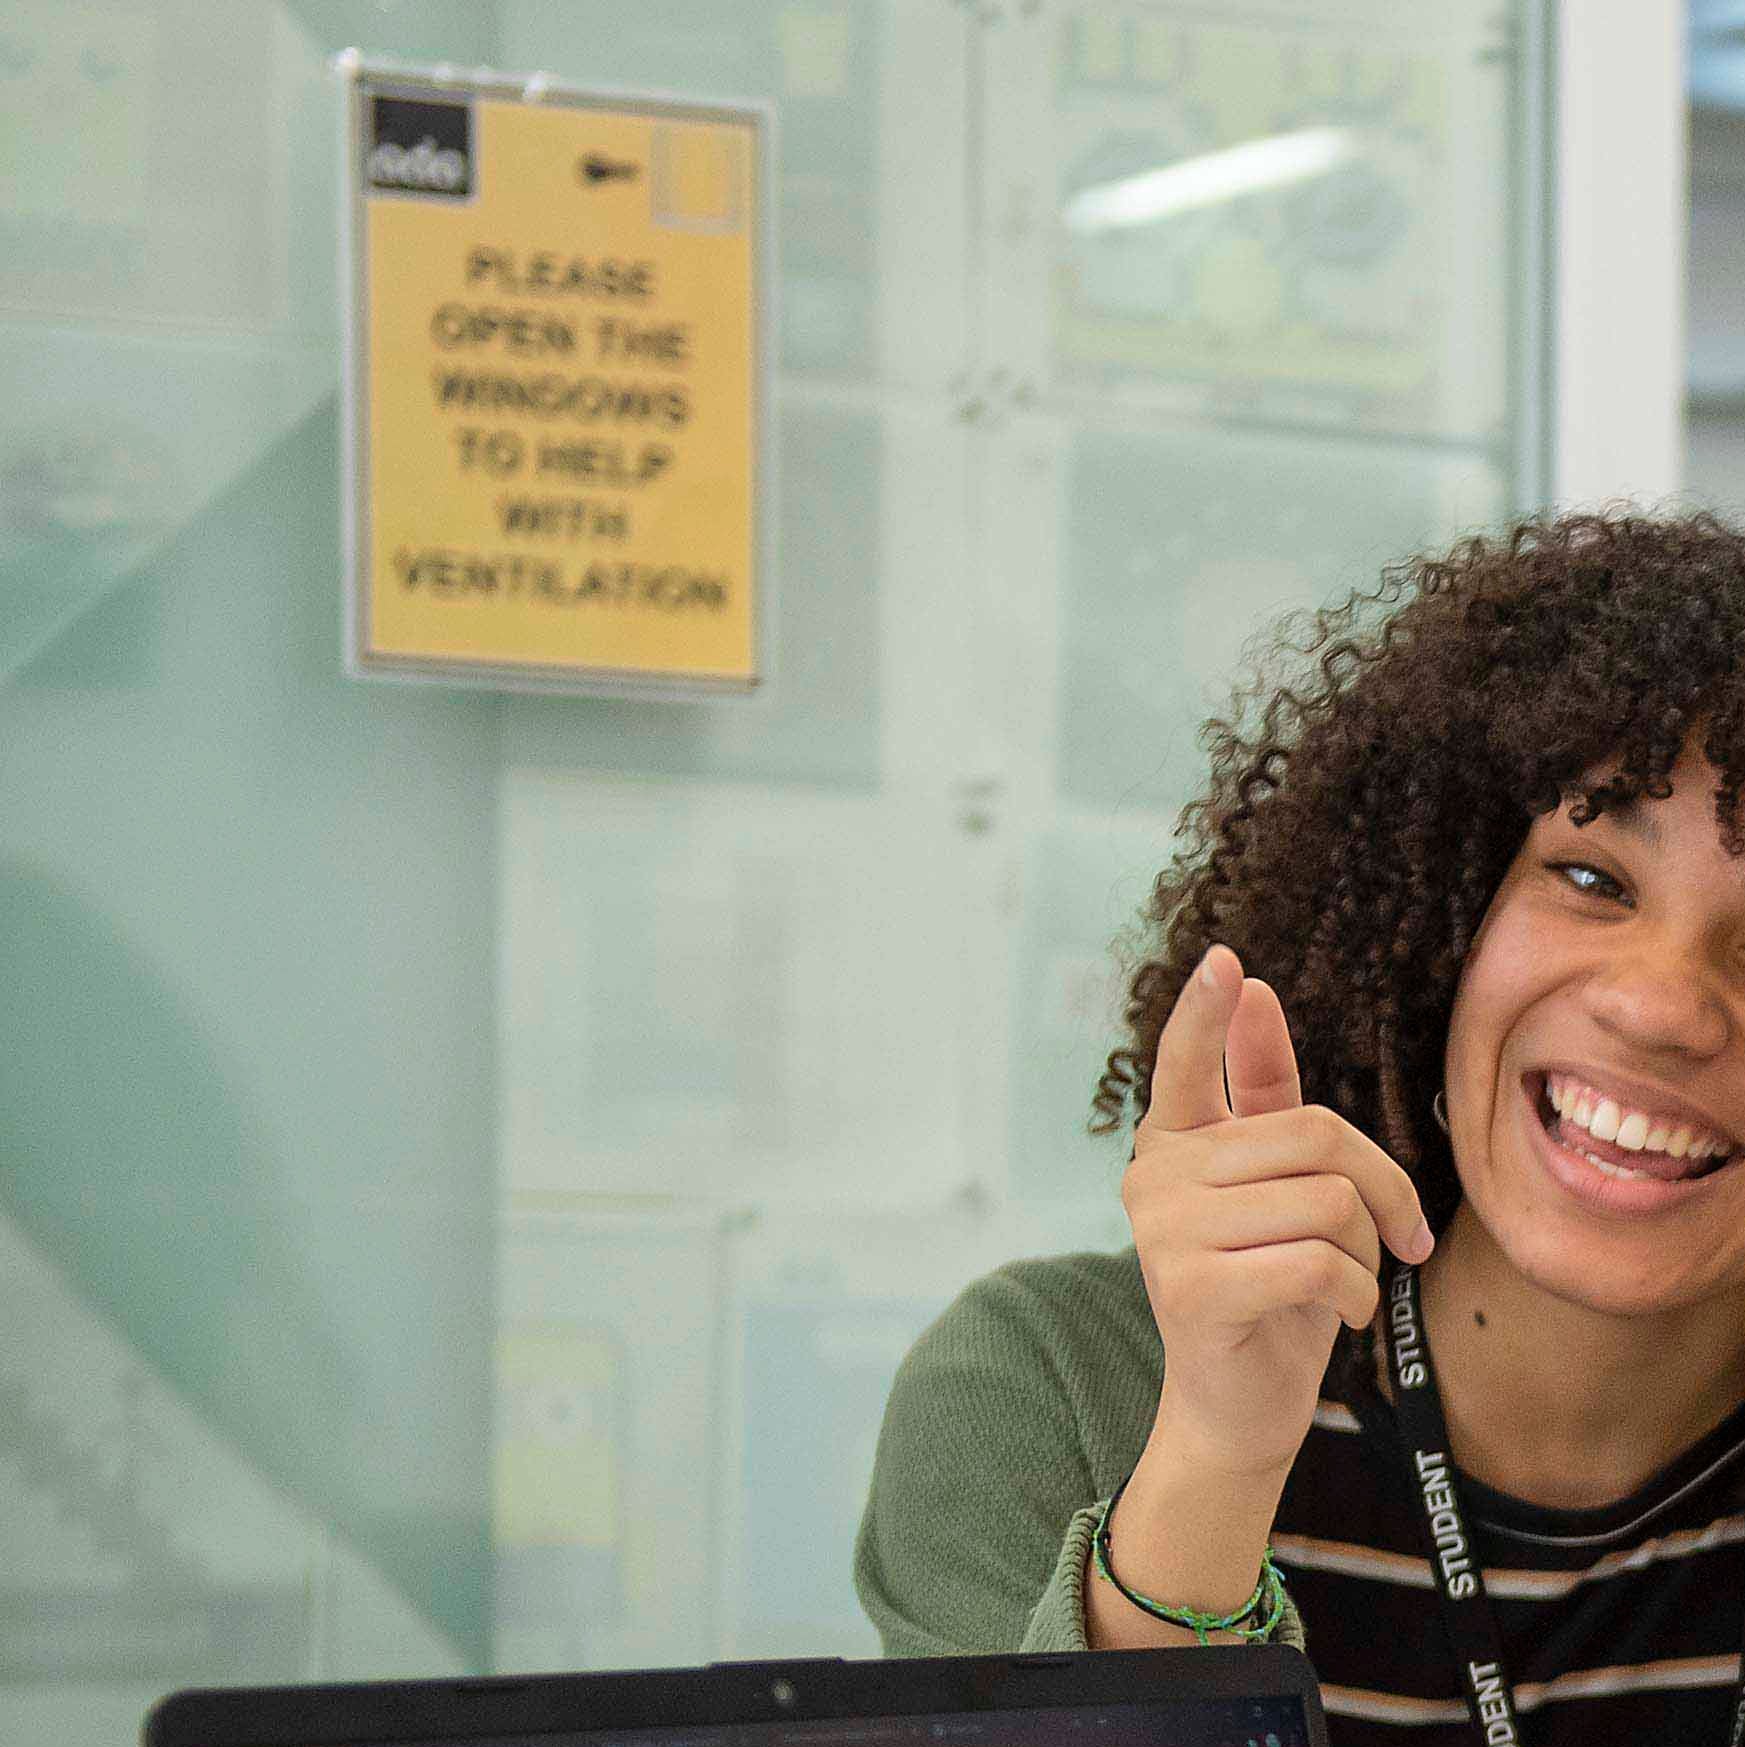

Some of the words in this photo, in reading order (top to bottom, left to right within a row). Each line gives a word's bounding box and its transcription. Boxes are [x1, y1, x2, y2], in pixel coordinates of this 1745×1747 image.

[466, 246, 656, 300] PLEASE
[430, 305, 576, 359] OPEN
[596, 316, 692, 367] THE
[433, 368, 690, 428] WINDOWS
[457, 427, 518, 475] TO
[536, 438, 674, 487] HELP
[499, 493, 628, 544] WITH
[394, 550, 731, 614] VENTILATION
[1391, 1265, 1425, 1389] STUDEN
[1415, 1449, 1479, 1600] STUDENT
